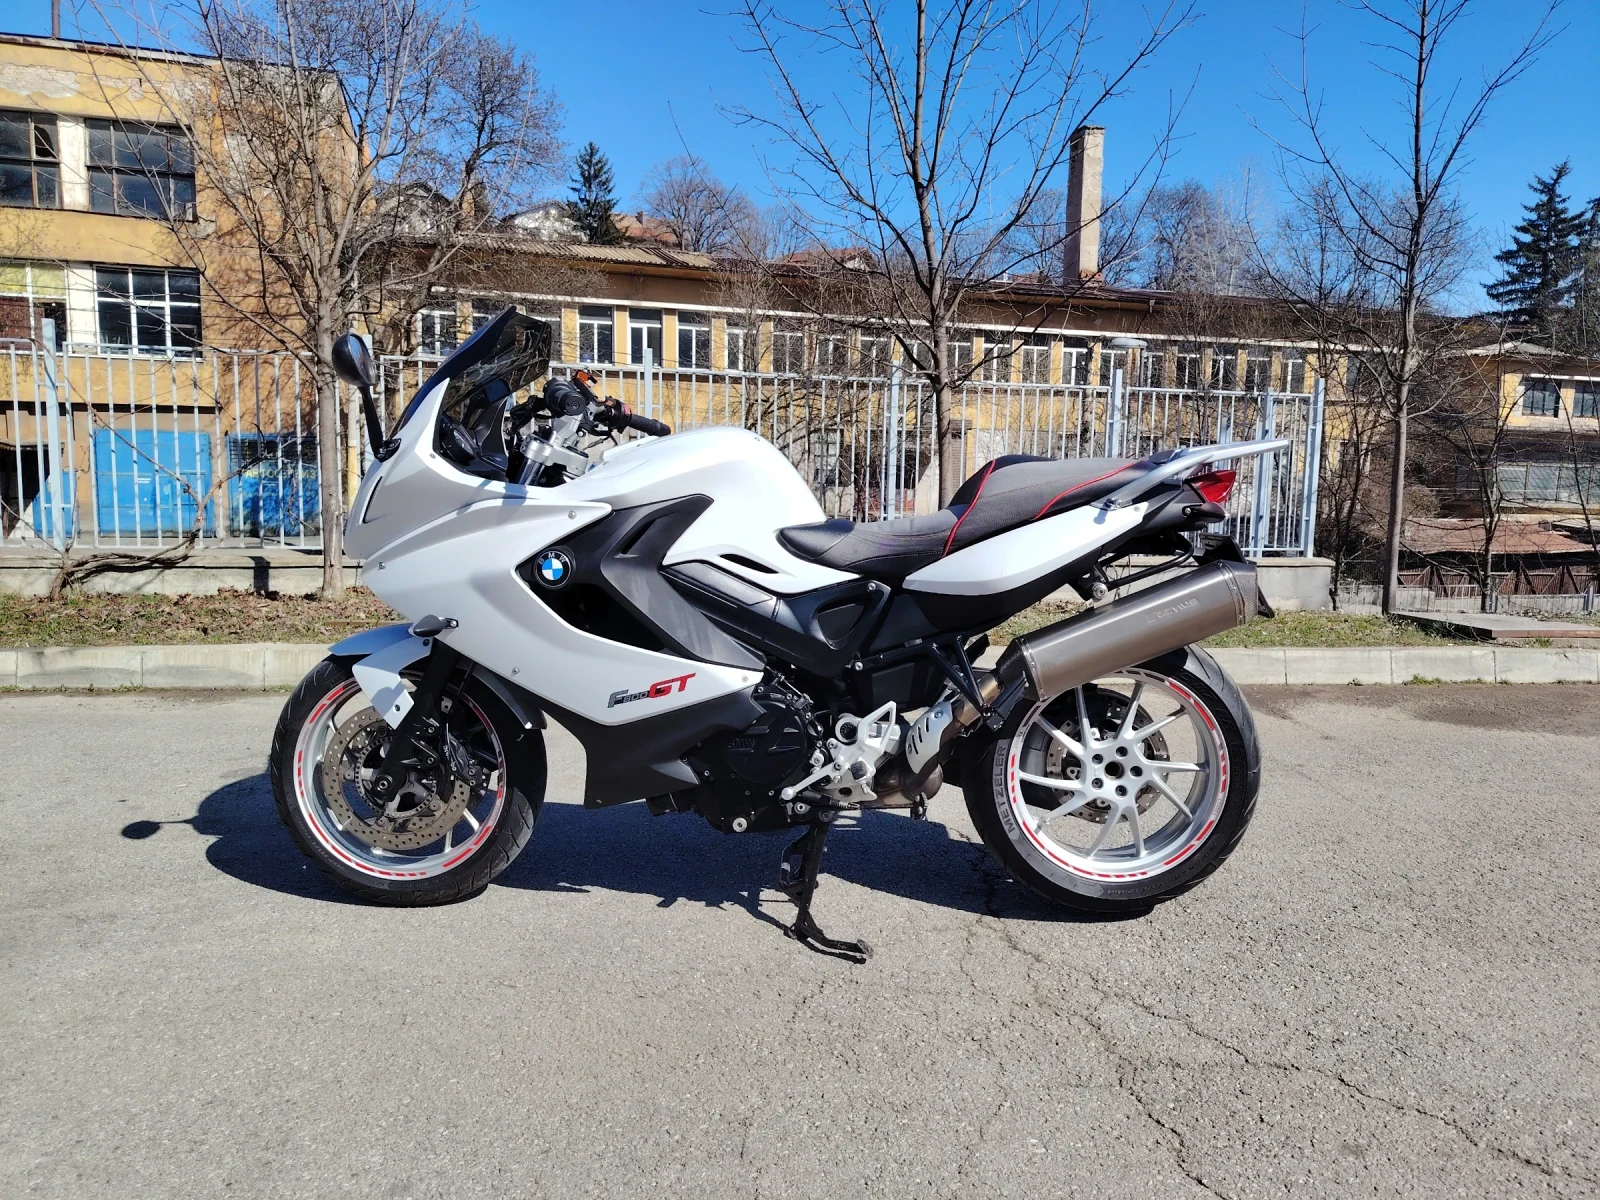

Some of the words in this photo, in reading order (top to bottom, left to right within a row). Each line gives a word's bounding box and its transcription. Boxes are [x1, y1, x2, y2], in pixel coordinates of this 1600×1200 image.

[245, 468, 316, 479] АВТОСЕВИЗ
[538, 552, 567, 565] BMW
[994, 745, 1015, 833] METZELER
